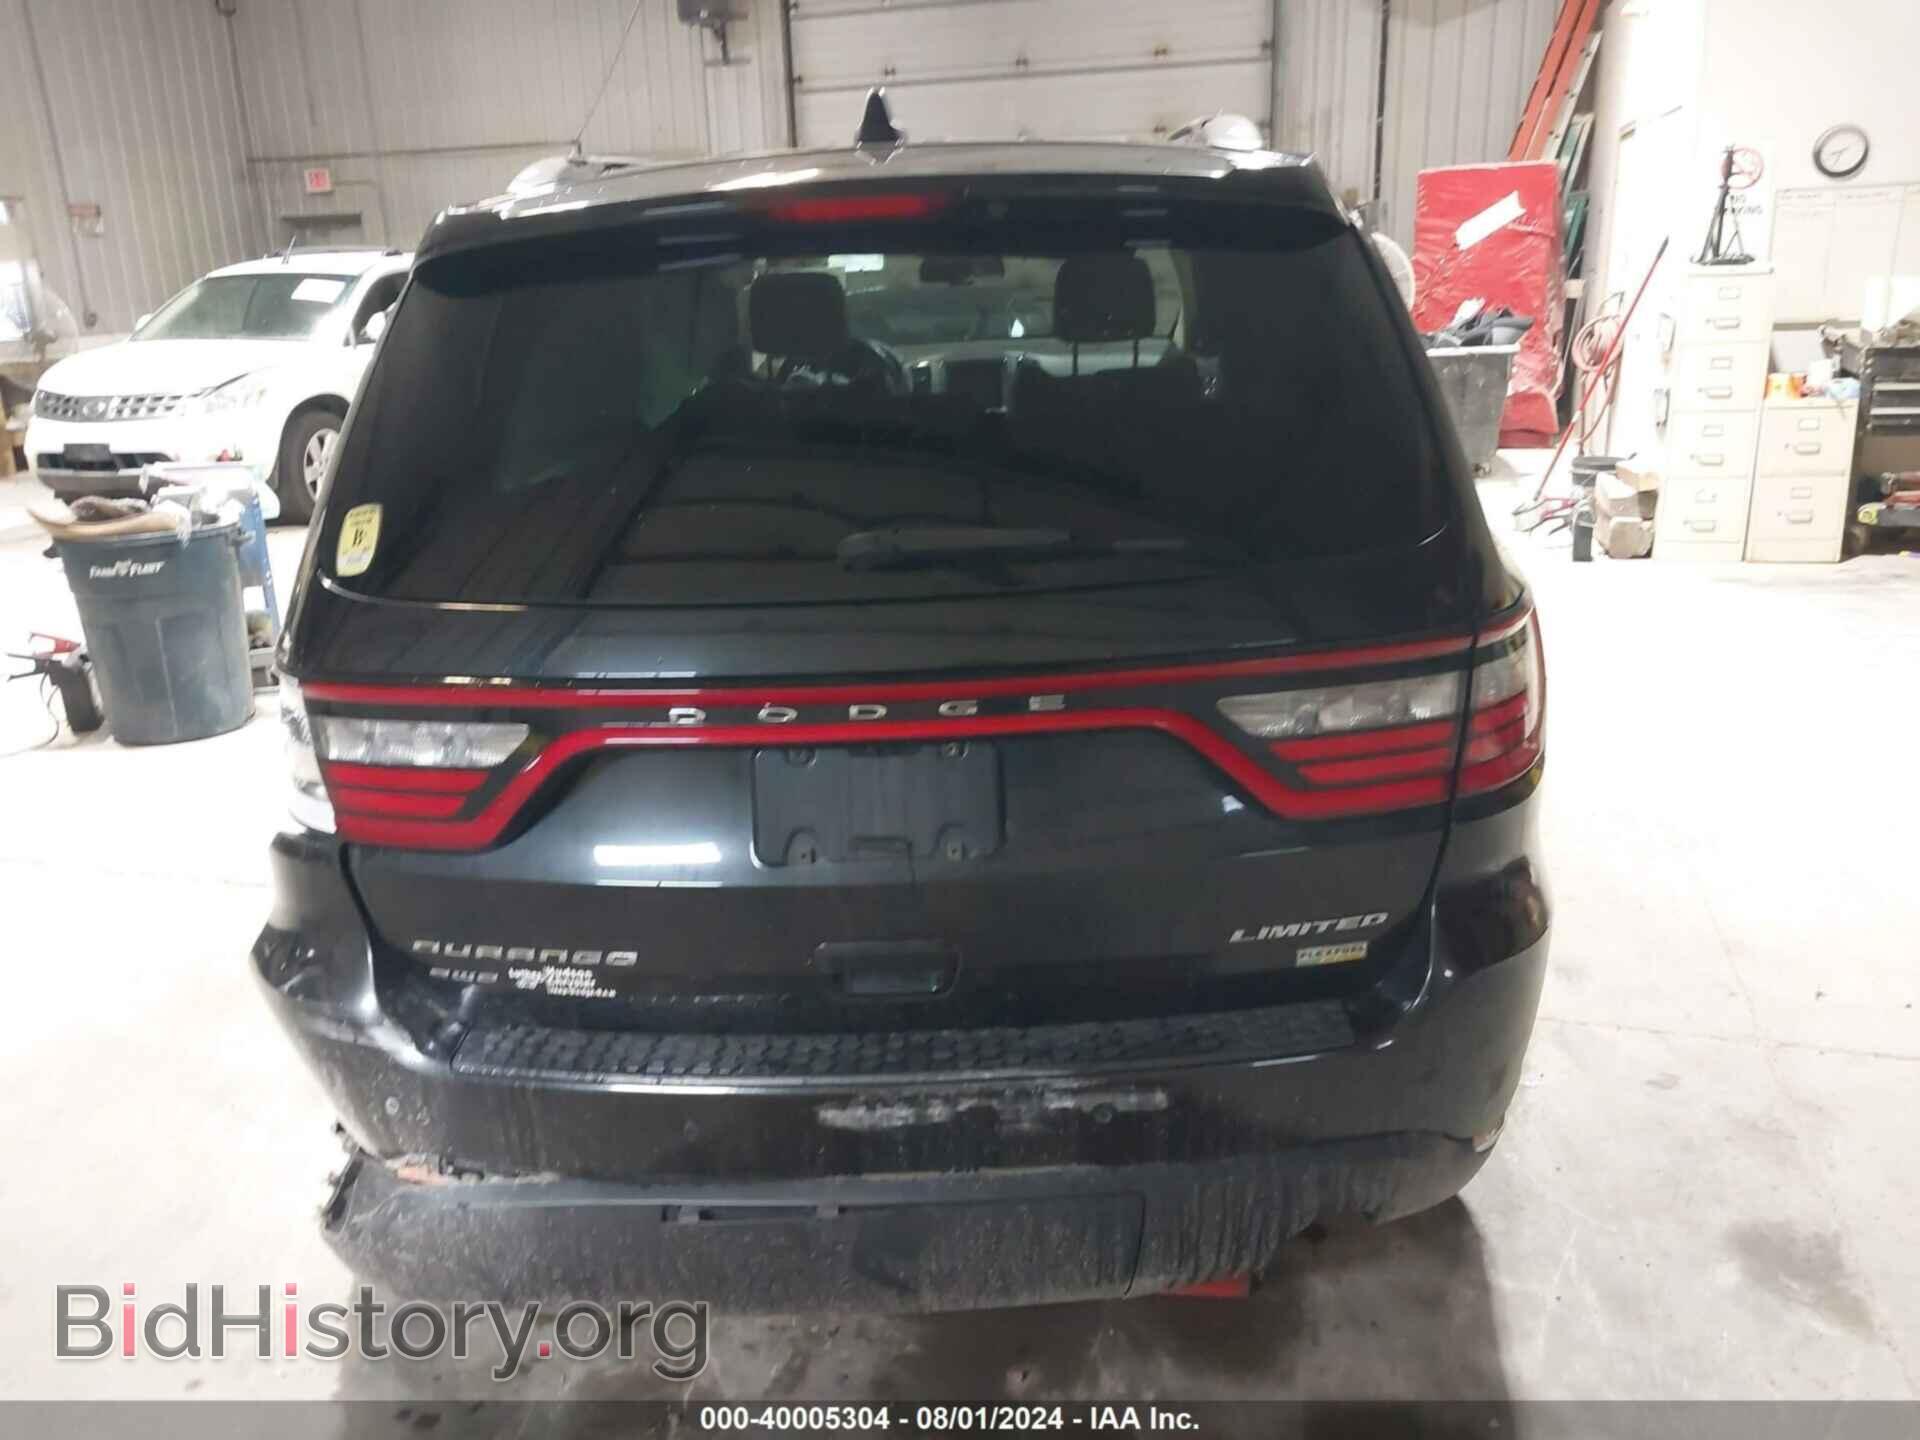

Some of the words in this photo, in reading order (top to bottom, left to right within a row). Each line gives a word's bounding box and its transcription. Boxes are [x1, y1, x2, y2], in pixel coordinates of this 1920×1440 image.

[669, 694, 1065, 724] DODGE
[1229, 911, 1389, 943] LIMITED
[412, 940, 638, 966] DURANGO
